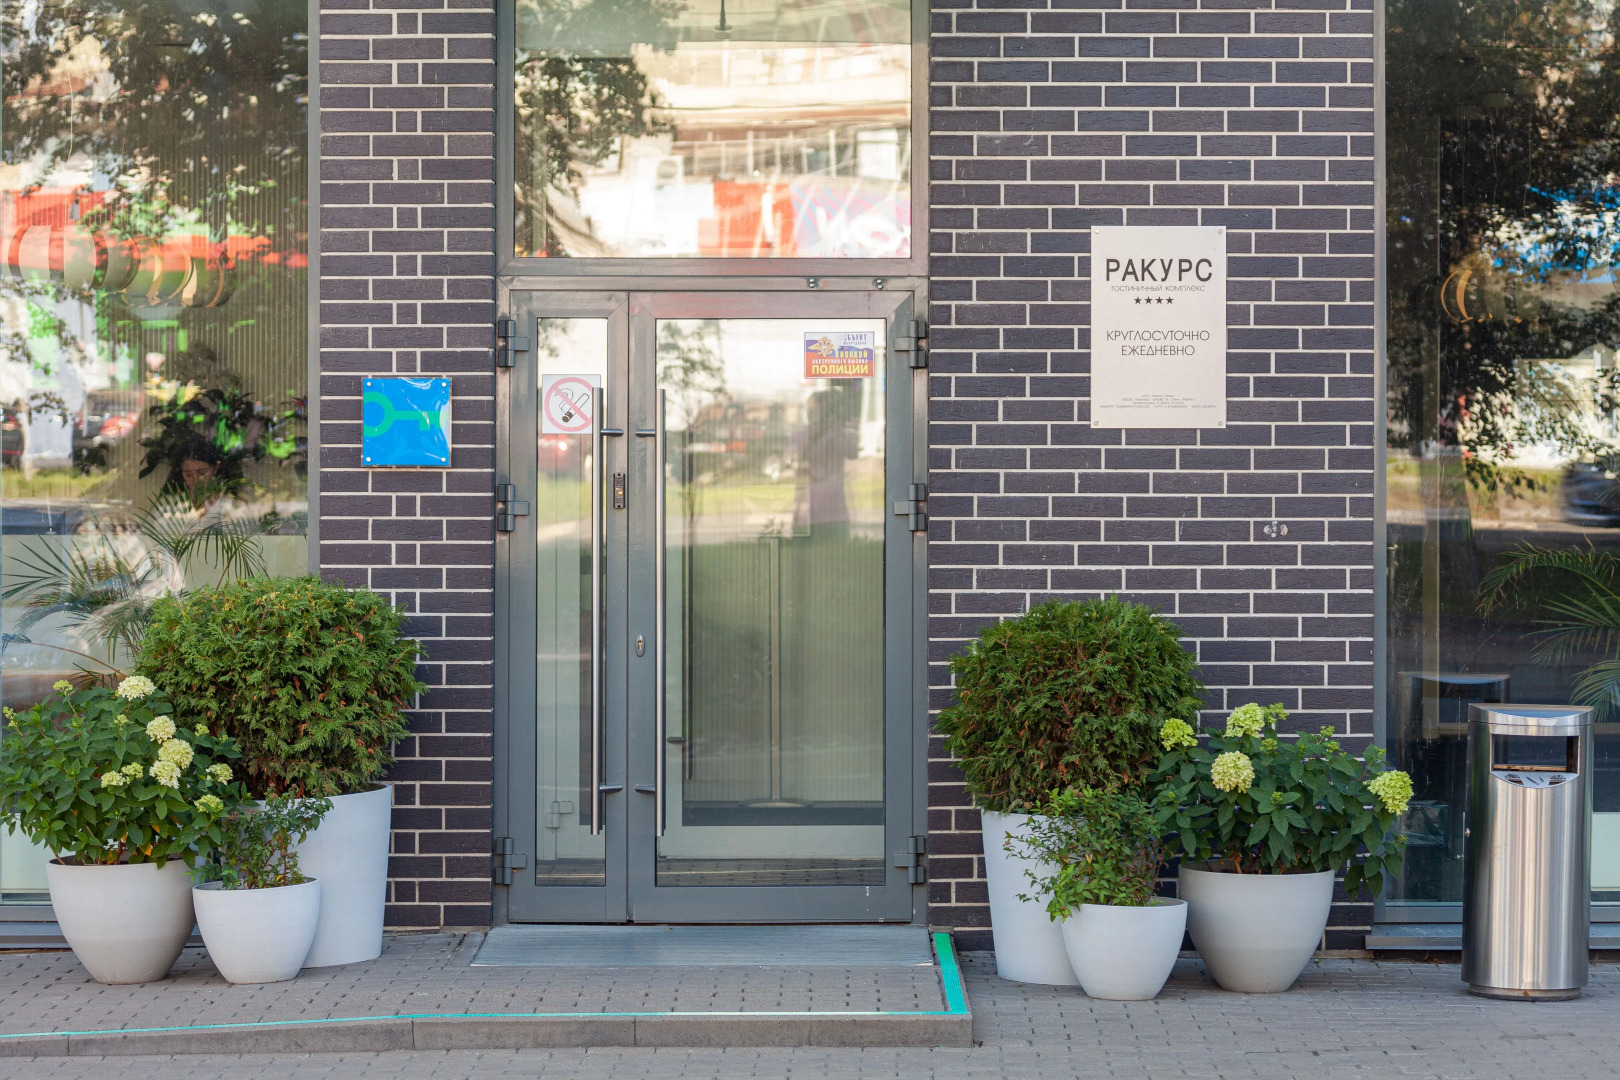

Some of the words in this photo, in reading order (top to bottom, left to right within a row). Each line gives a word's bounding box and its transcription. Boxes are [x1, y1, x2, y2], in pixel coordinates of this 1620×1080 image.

[1105, 258, 1213, 282] РАКУРС
[1106, 330, 1210, 341] КРУГЛОСУТОЧНО
[1121, 345, 1196, 356] ЕЖЕДНЕВНО
[812, 364, 869, 375] ПОЛИЦИИ
